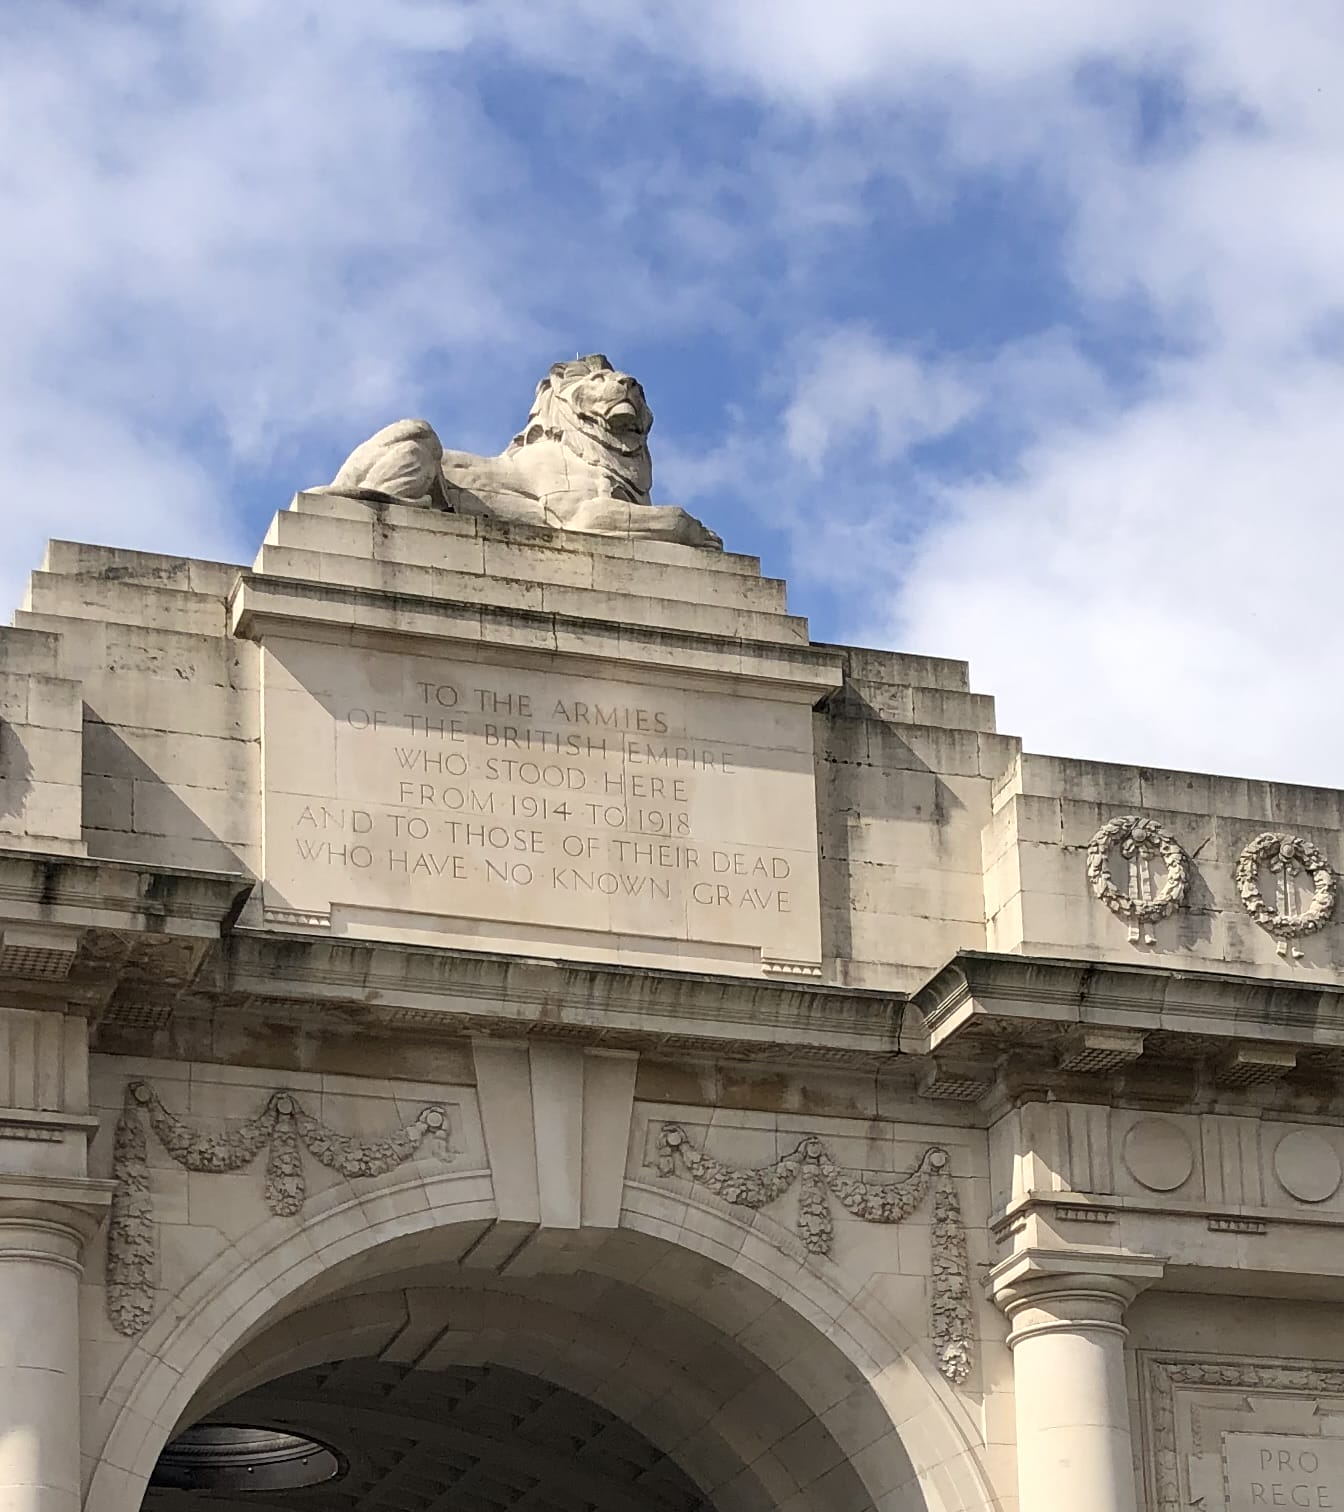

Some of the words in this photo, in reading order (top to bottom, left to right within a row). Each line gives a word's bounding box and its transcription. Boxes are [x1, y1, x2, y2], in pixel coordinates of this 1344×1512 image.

[416, 682, 458, 707] TO
[474, 689, 532, 717] THE
[553, 700, 668, 733] ARMIES
[347, 708, 387, 731] OF
[404, 714, 465, 742] THE
[485, 724, 606, 760] BRITISH
[627, 741, 736, 774] EMPIRE
[395, 748, 467, 776] WHO
[486, 758, 586, 790] STOOD
[605, 771, 688, 802] HERE
[399, 782, 494, 814] FROM
[512, 795, 572, 821] 1914
[586, 803, 624, 827] TO
[639, 810, 691, 836] 1918
[297, 806, 373, 834] AND
[387, 814, 429, 839] TO
[445, 821, 545, 854] THOSE
[563, 835, 600, 858] OF
[612, 840, 698, 869] THEIR
[713, 851, 790, 879] DEAD
[296, 838, 373, 868] WHO
[389, 849, 467, 879] HAVE
[485, 859, 533, 885] NO
[553, 867, 670, 899] KNOWN
[693, 882, 791, 913] GRAVE
[1260, 1449, 1319, 1474] PRO
[1251, 1482, 1333, 1508] REGE
